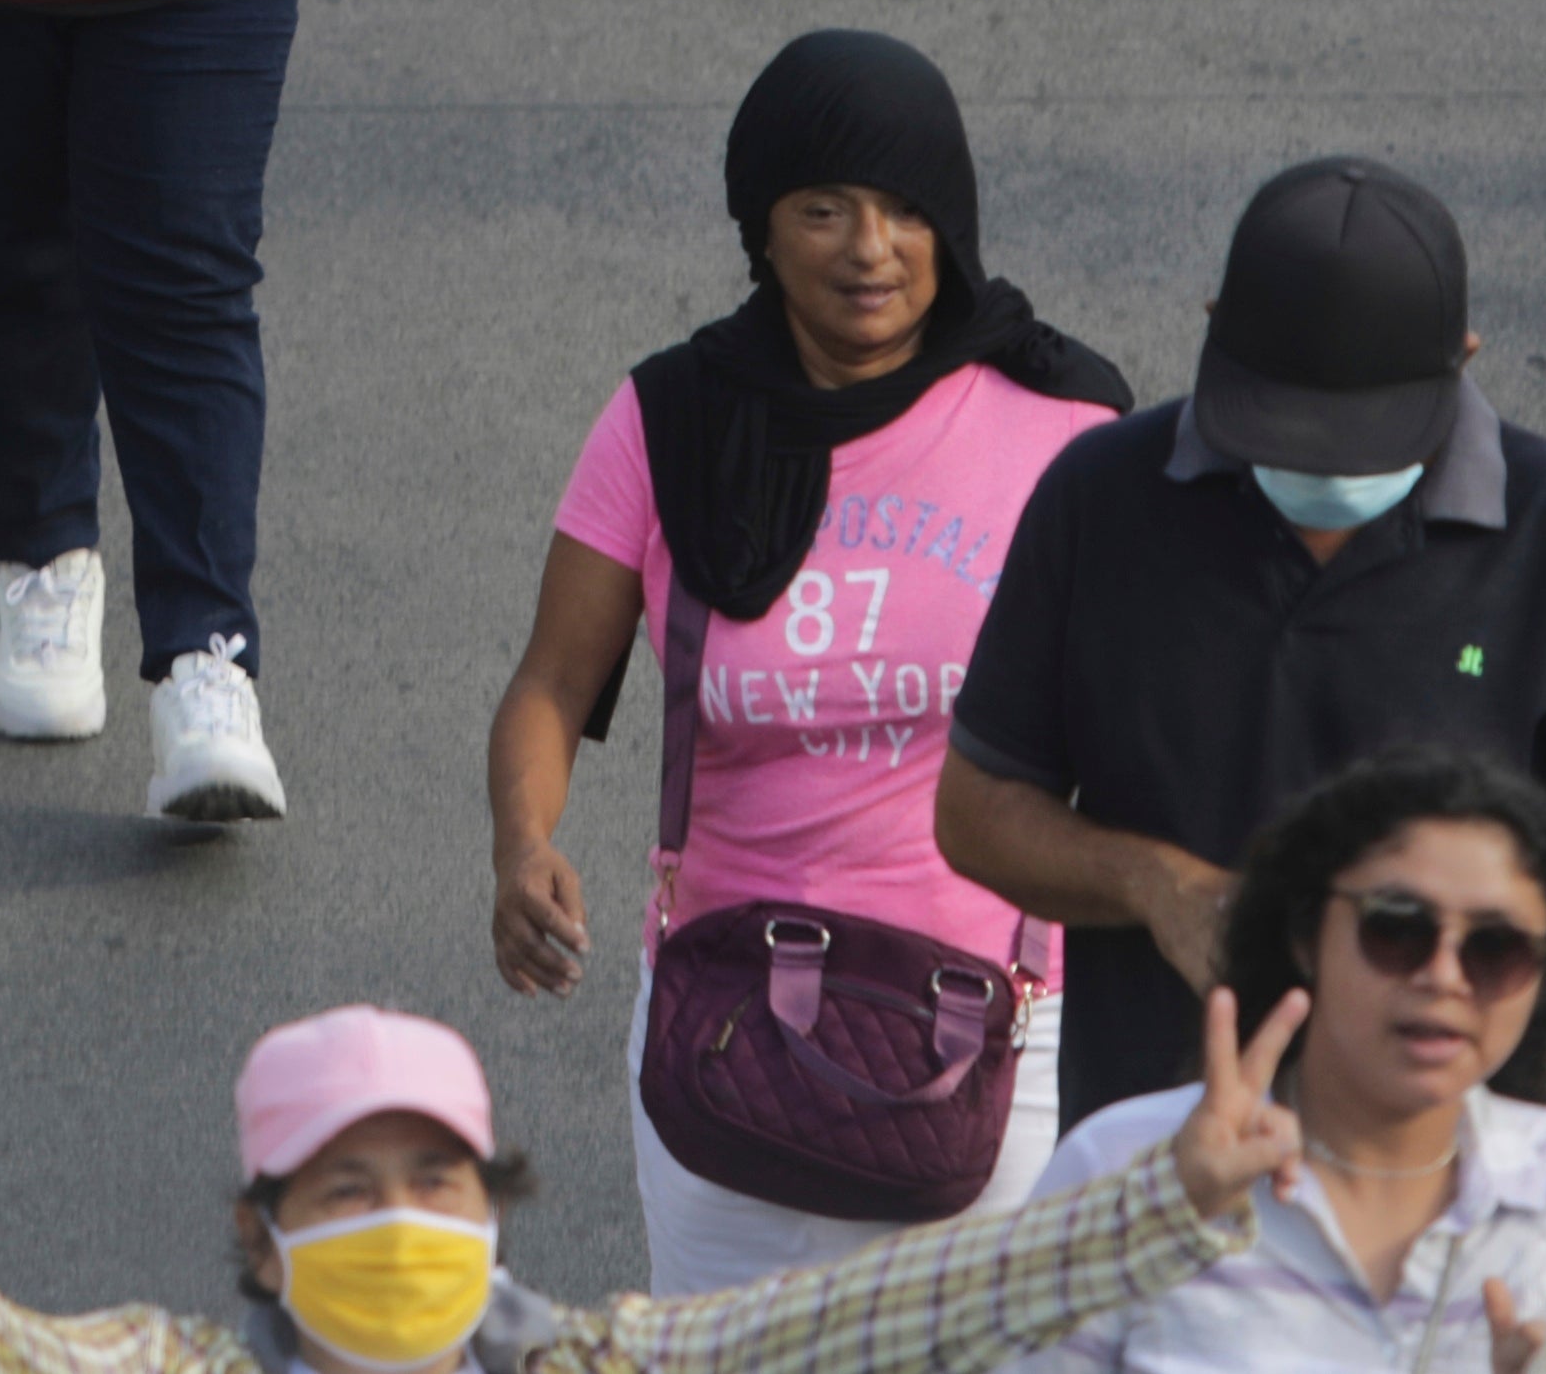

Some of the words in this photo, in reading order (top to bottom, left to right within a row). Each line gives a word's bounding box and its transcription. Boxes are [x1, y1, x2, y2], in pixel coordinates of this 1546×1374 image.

[784, 567, 891, 657] 87
[701, 662, 821, 724] NEW
[850, 658, 968, 718] YOR
[799, 722, 915, 769] CITY
